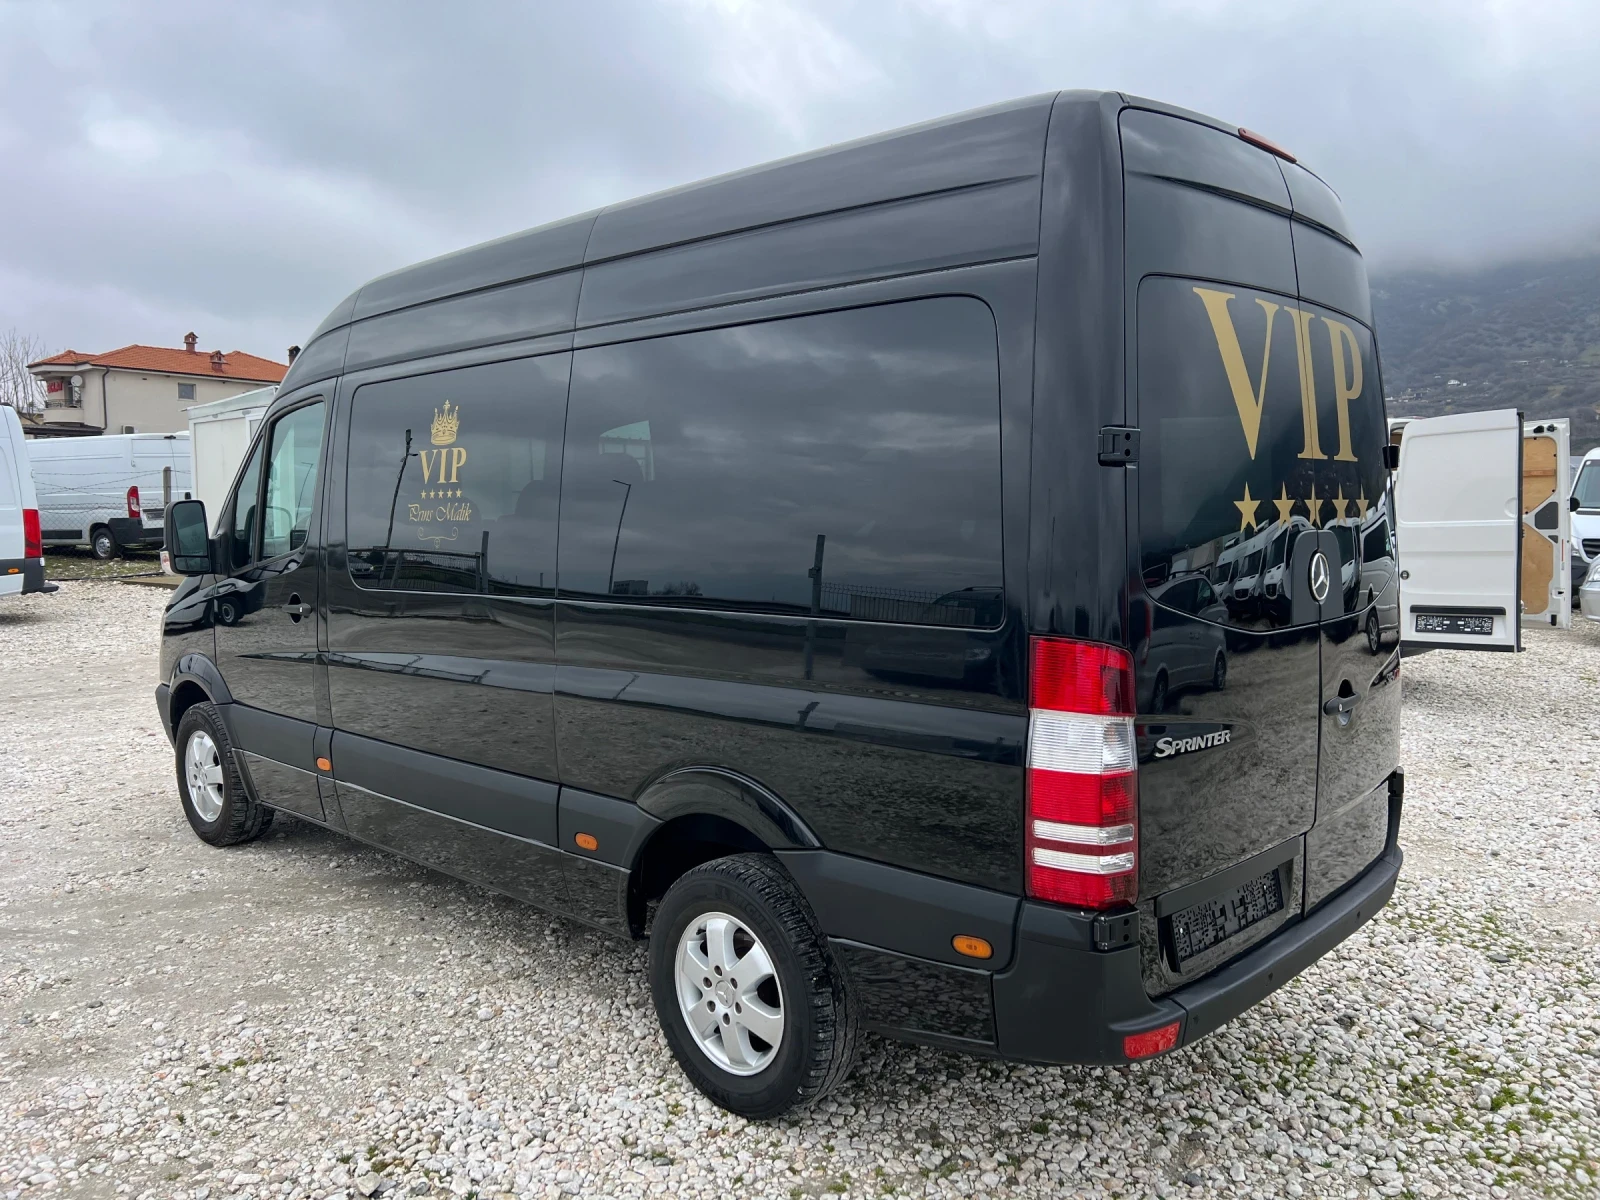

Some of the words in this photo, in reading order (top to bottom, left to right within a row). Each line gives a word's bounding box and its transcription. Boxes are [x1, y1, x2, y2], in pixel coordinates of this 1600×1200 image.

[1192, 287, 1363, 462] VIP
[419, 447, 467, 484] VIP
[436, 503, 472, 521] Malik
[1155, 730, 1231, 758] SPRINTER
